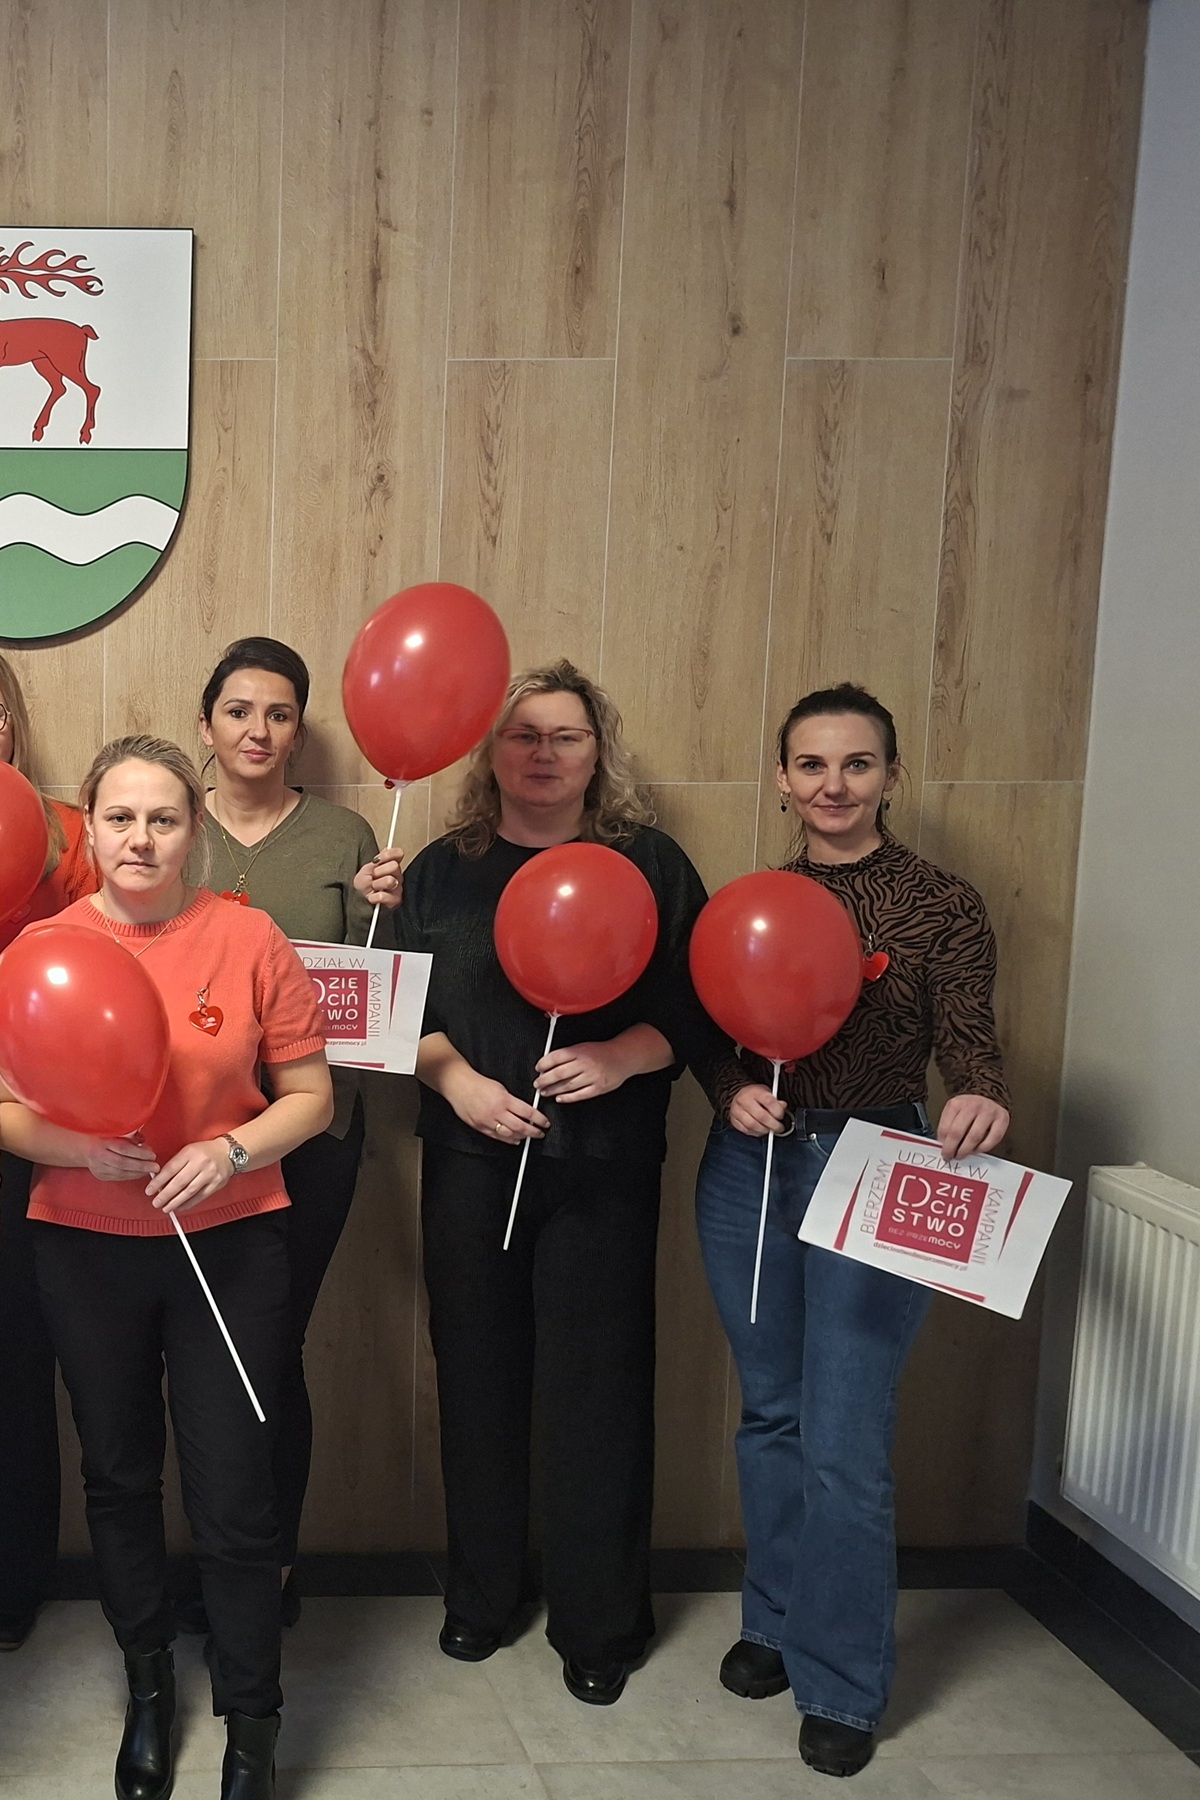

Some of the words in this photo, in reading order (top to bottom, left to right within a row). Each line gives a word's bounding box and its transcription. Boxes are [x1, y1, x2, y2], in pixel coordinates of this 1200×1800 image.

[302, 956, 345, 969] DZIAŁ
[349, 957, 365, 968] W
[321, 1008, 358, 1021] WO
[368, 972, 381, 1037] KAMPANII
[898, 1149, 963, 1175] UDZIAŁ
[968, 1164, 989, 1180] W
[860, 1159, 892, 1235] BIERZEMY
[897, 1174, 974, 1208] DZIE
[891, 1207, 965, 1238] STWO
[971, 1187, 1004, 1265] KAMPANII
